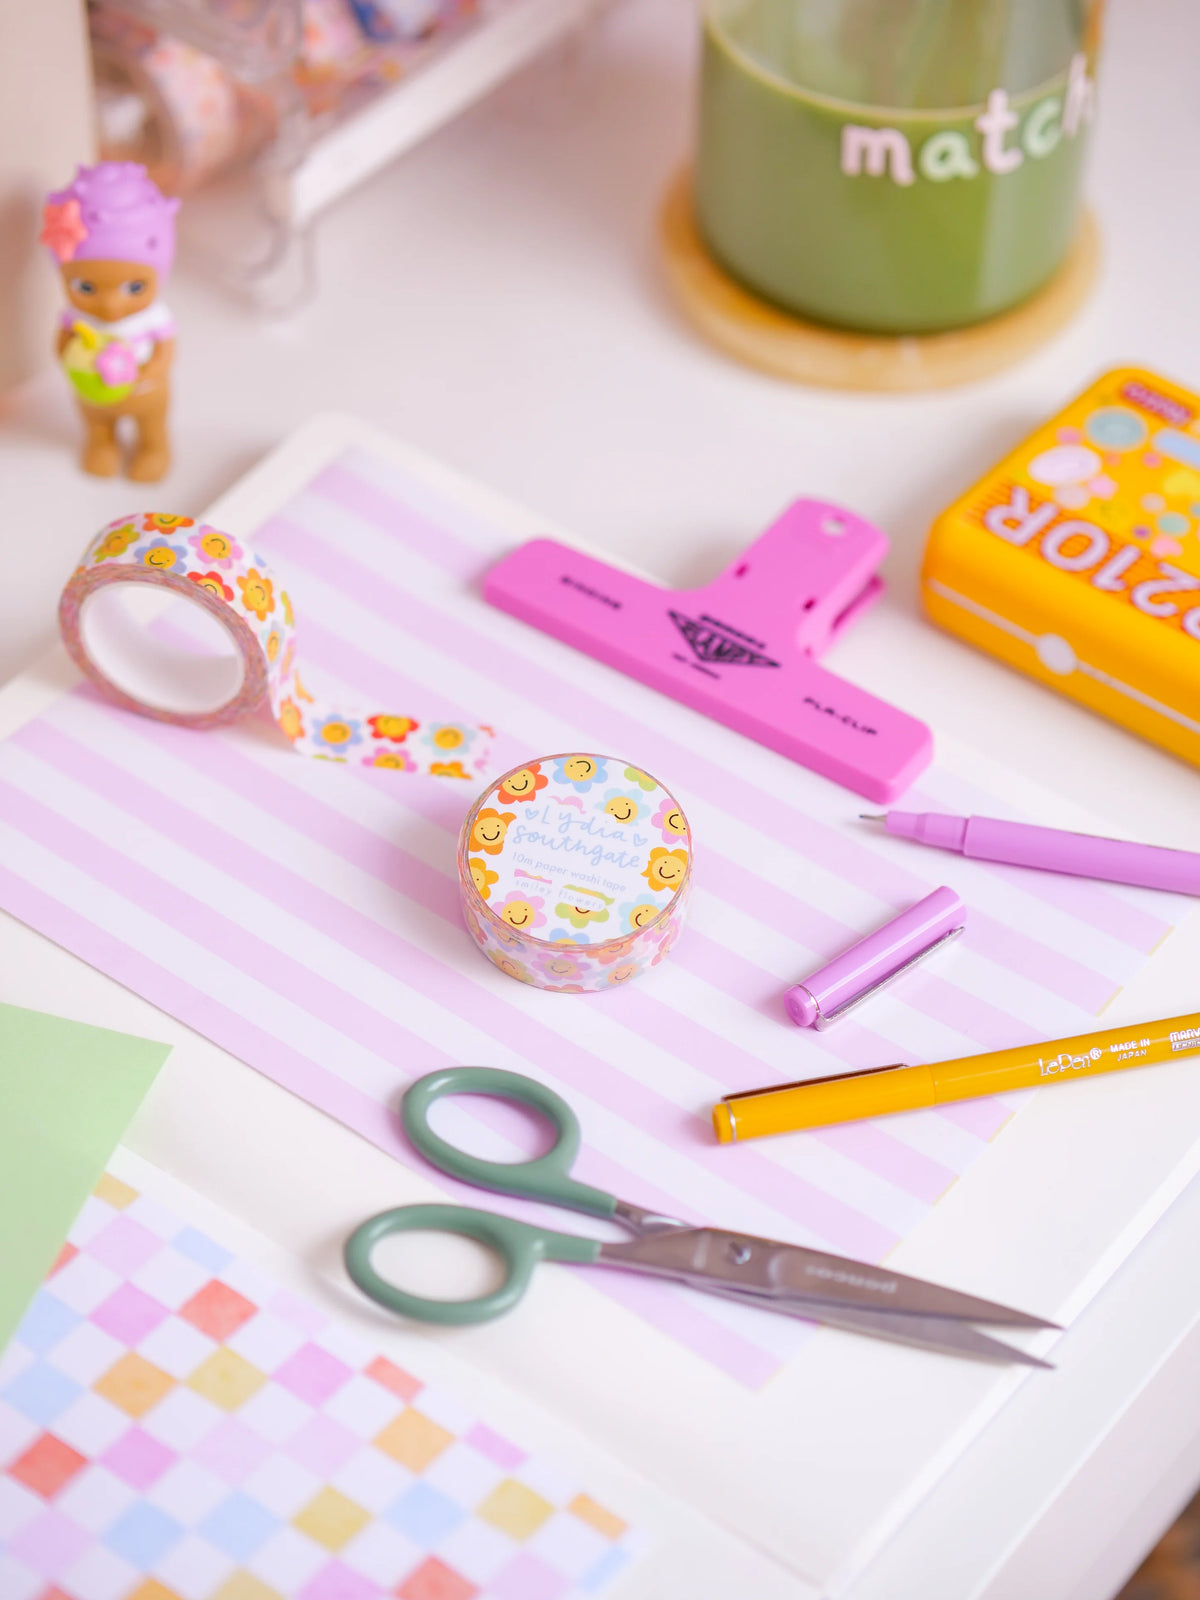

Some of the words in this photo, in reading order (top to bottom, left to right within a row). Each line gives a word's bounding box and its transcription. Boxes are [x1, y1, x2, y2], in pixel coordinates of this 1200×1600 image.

[541, 804, 627, 842] Lydia
[512, 851, 533, 866] 10m
[535, 861, 568, 876] paper
[570, 871, 600, 886] washi
[603, 879, 627, 892] tape
[516, 879, 552, 895] smiley
[559, 888, 604, 910] flowers
[1109, 1041, 1137, 1053] MADE
[1140, 1038, 1150, 1048] IN
[1117, 1049, 1147, 1061] JAPAN
